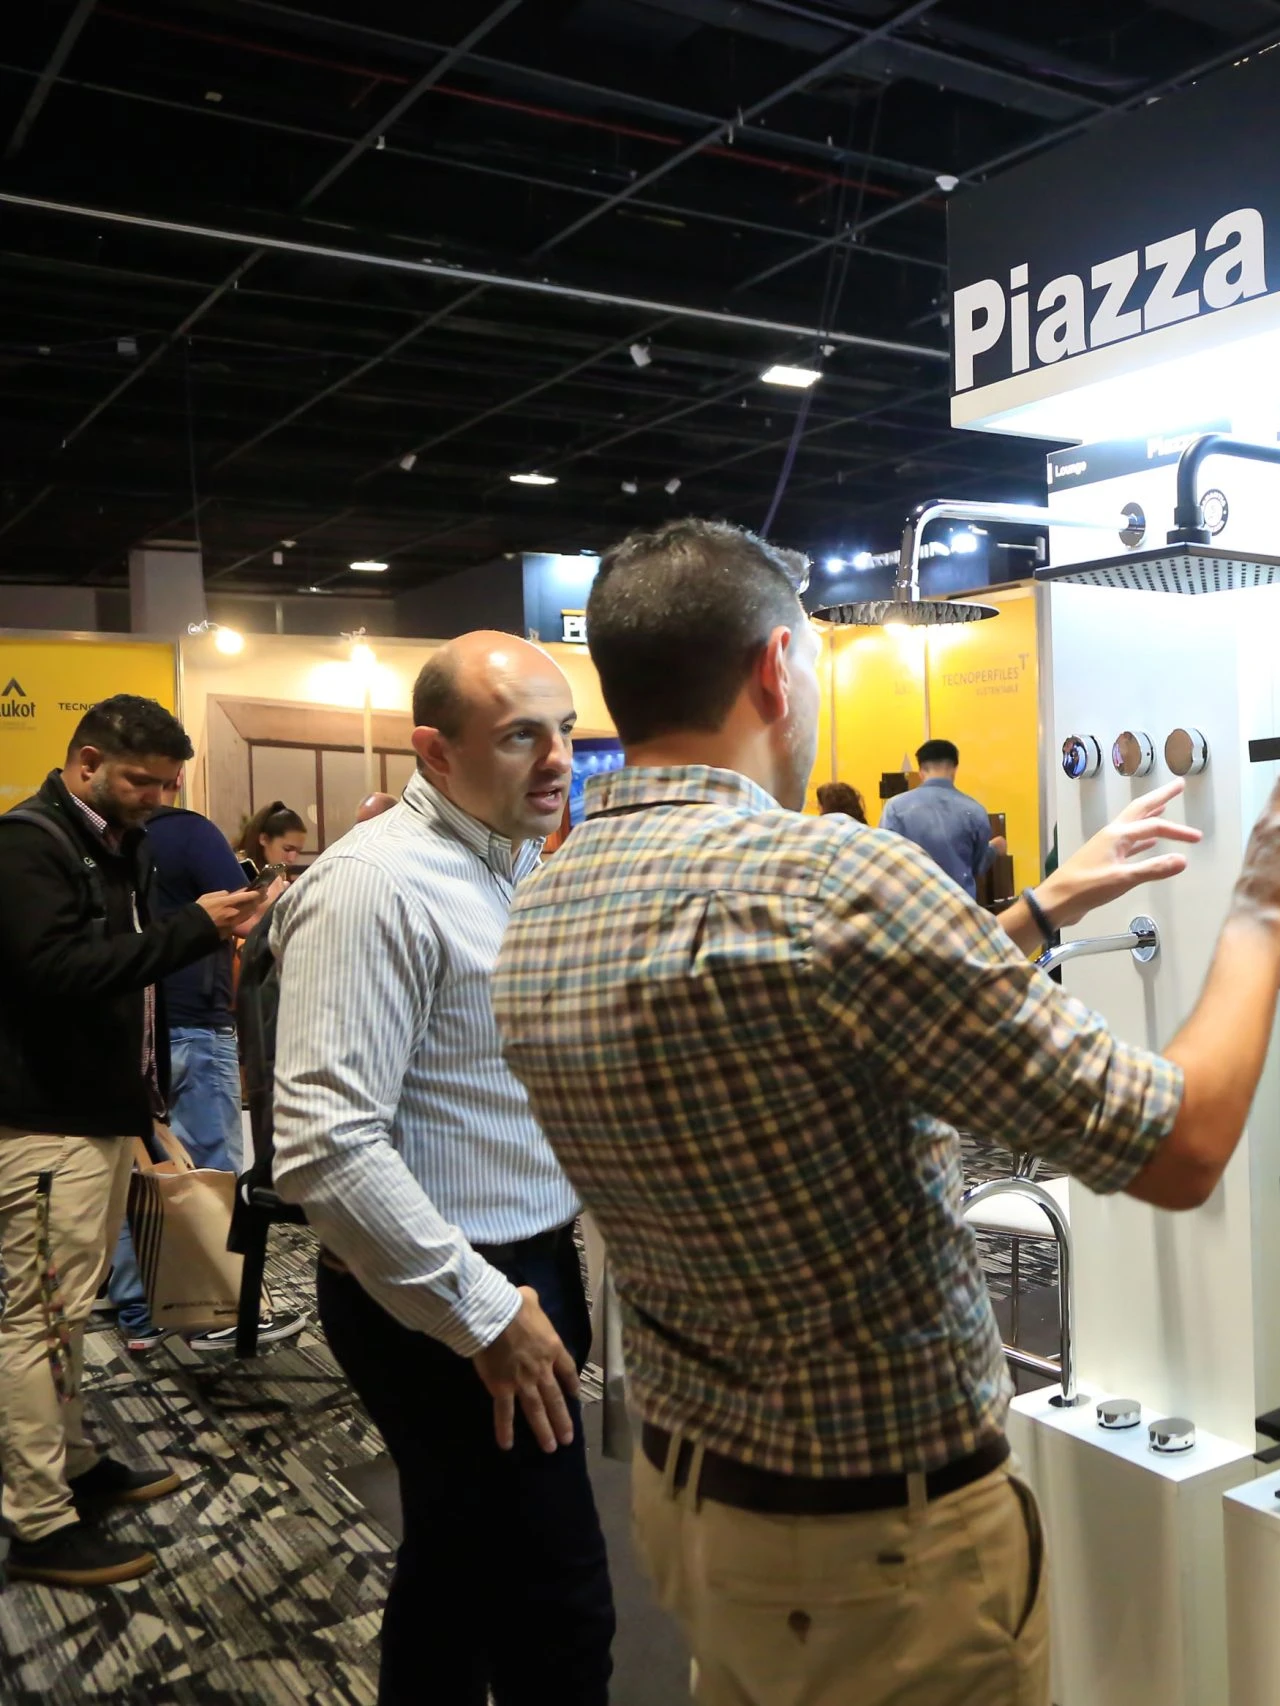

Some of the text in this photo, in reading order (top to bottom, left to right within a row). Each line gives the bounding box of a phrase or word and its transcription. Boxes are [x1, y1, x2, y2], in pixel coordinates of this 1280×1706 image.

[953, 207, 1268, 391] Piazza
[1055, 461, 1087, 477] Lounge
[942, 666, 1019, 686] TECNOPERFILES
[0, 699, 36, 718] ukot
